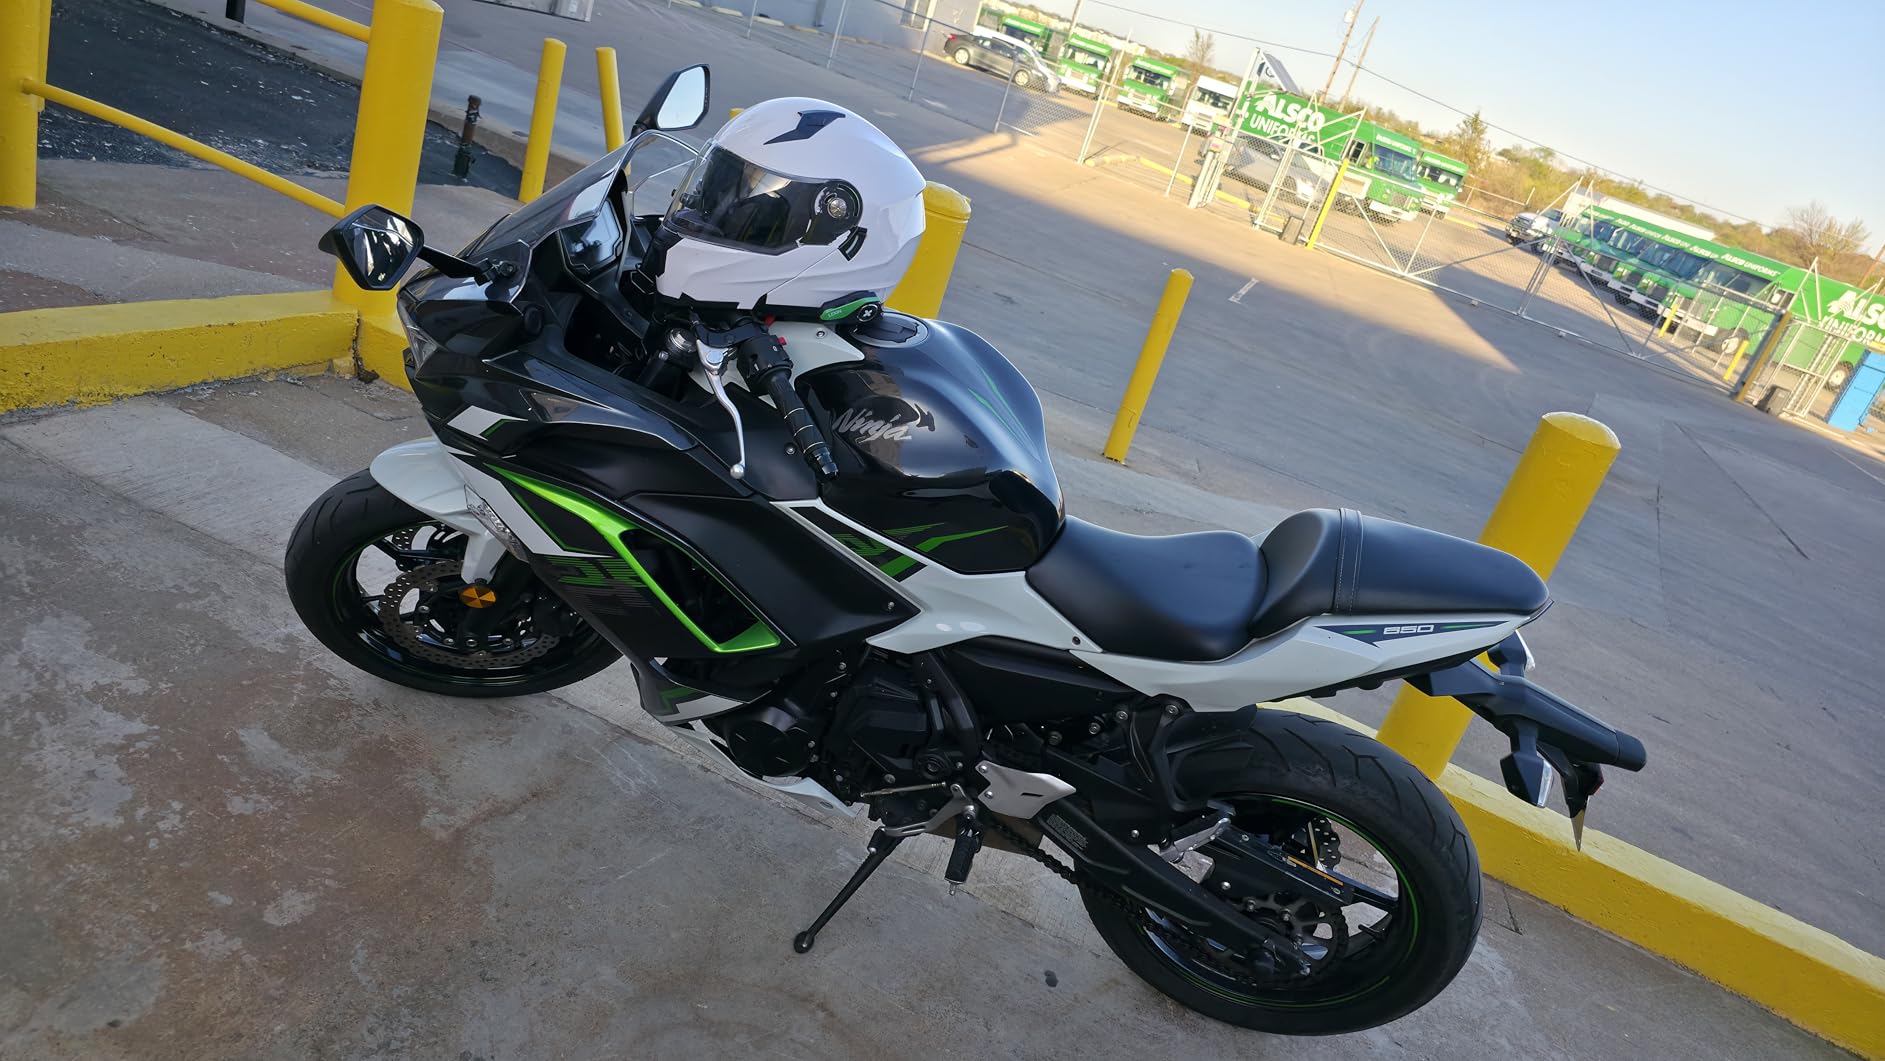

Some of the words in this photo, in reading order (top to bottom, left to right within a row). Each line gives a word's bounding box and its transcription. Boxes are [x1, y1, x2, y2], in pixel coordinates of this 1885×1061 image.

[1250, 113, 1315, 143] UNIFORS
[1255, 92, 1325, 131] ALSCO
[832, 408, 912, 444] Ninja
[1383, 624, 1434, 634] 650
